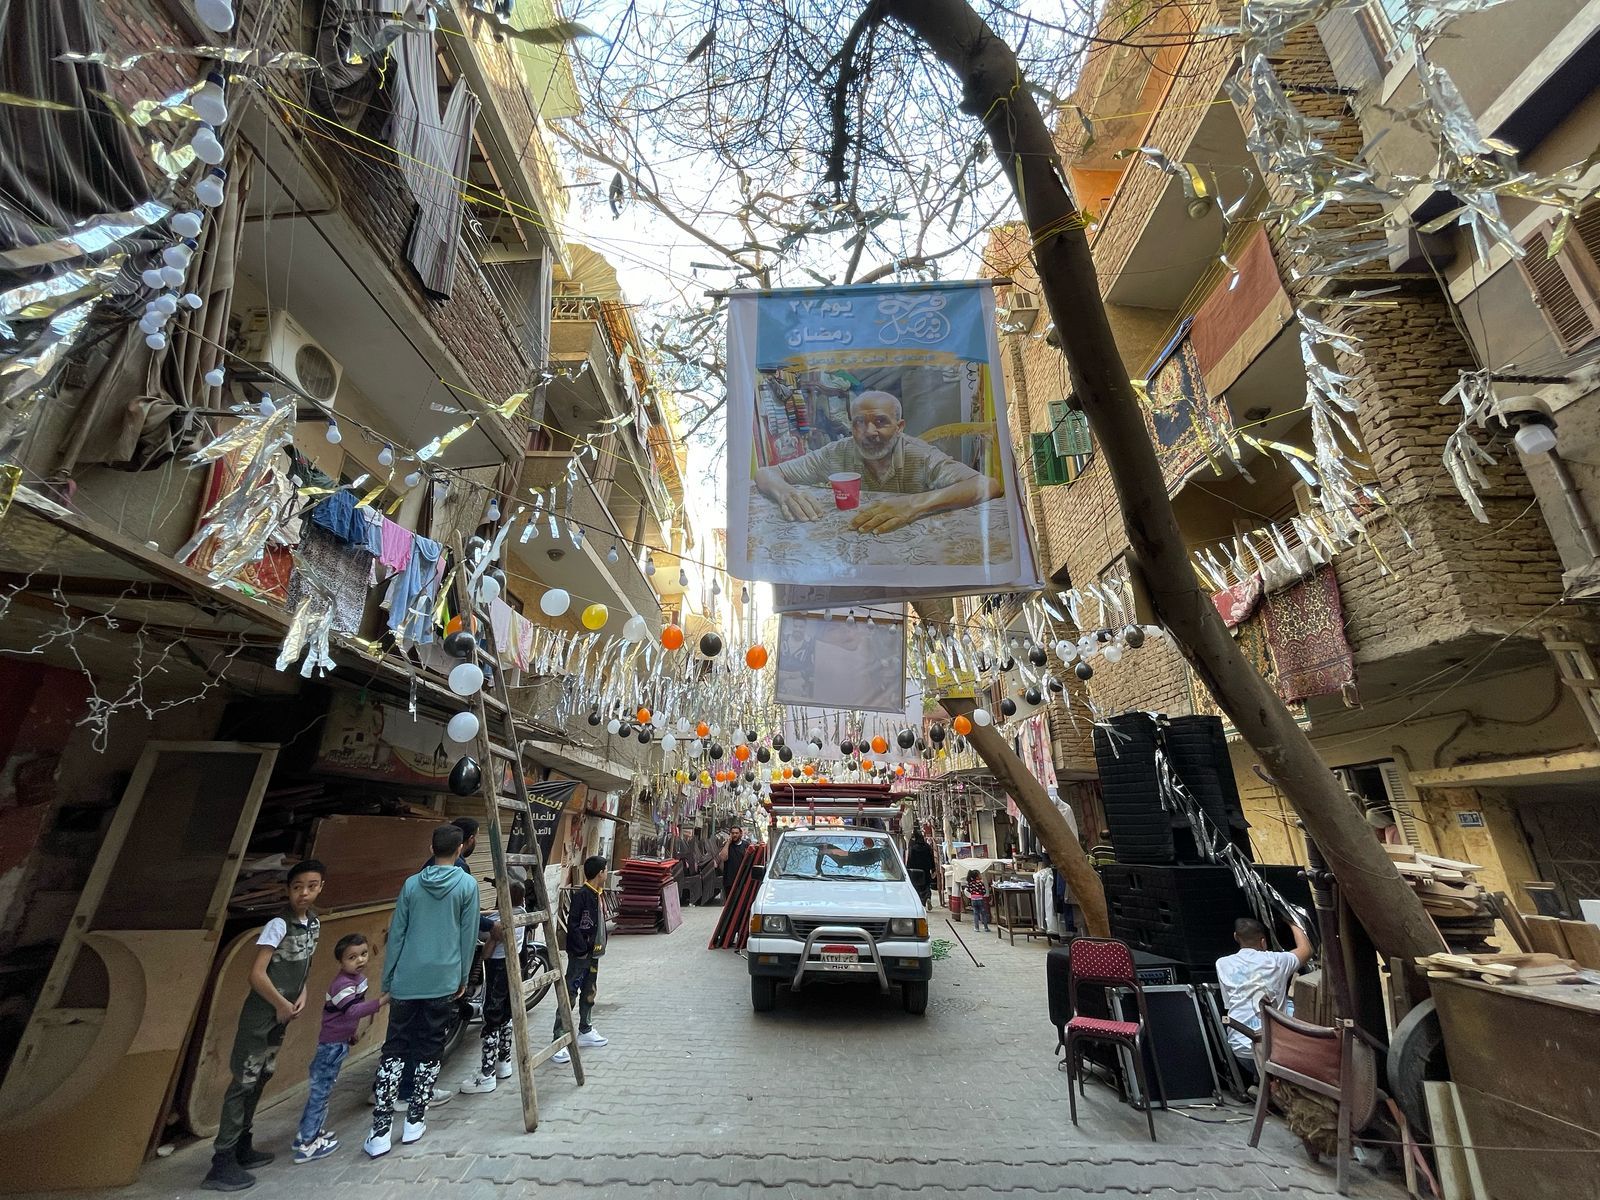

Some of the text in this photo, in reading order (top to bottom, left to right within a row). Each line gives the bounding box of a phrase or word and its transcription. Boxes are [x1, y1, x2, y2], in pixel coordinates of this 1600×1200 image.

[821, 301, 854, 318] يوم
[879, 311, 950, 344] فيصل
[788, 327, 852, 347] رمضان
[528, 794, 563, 810] الصفو
